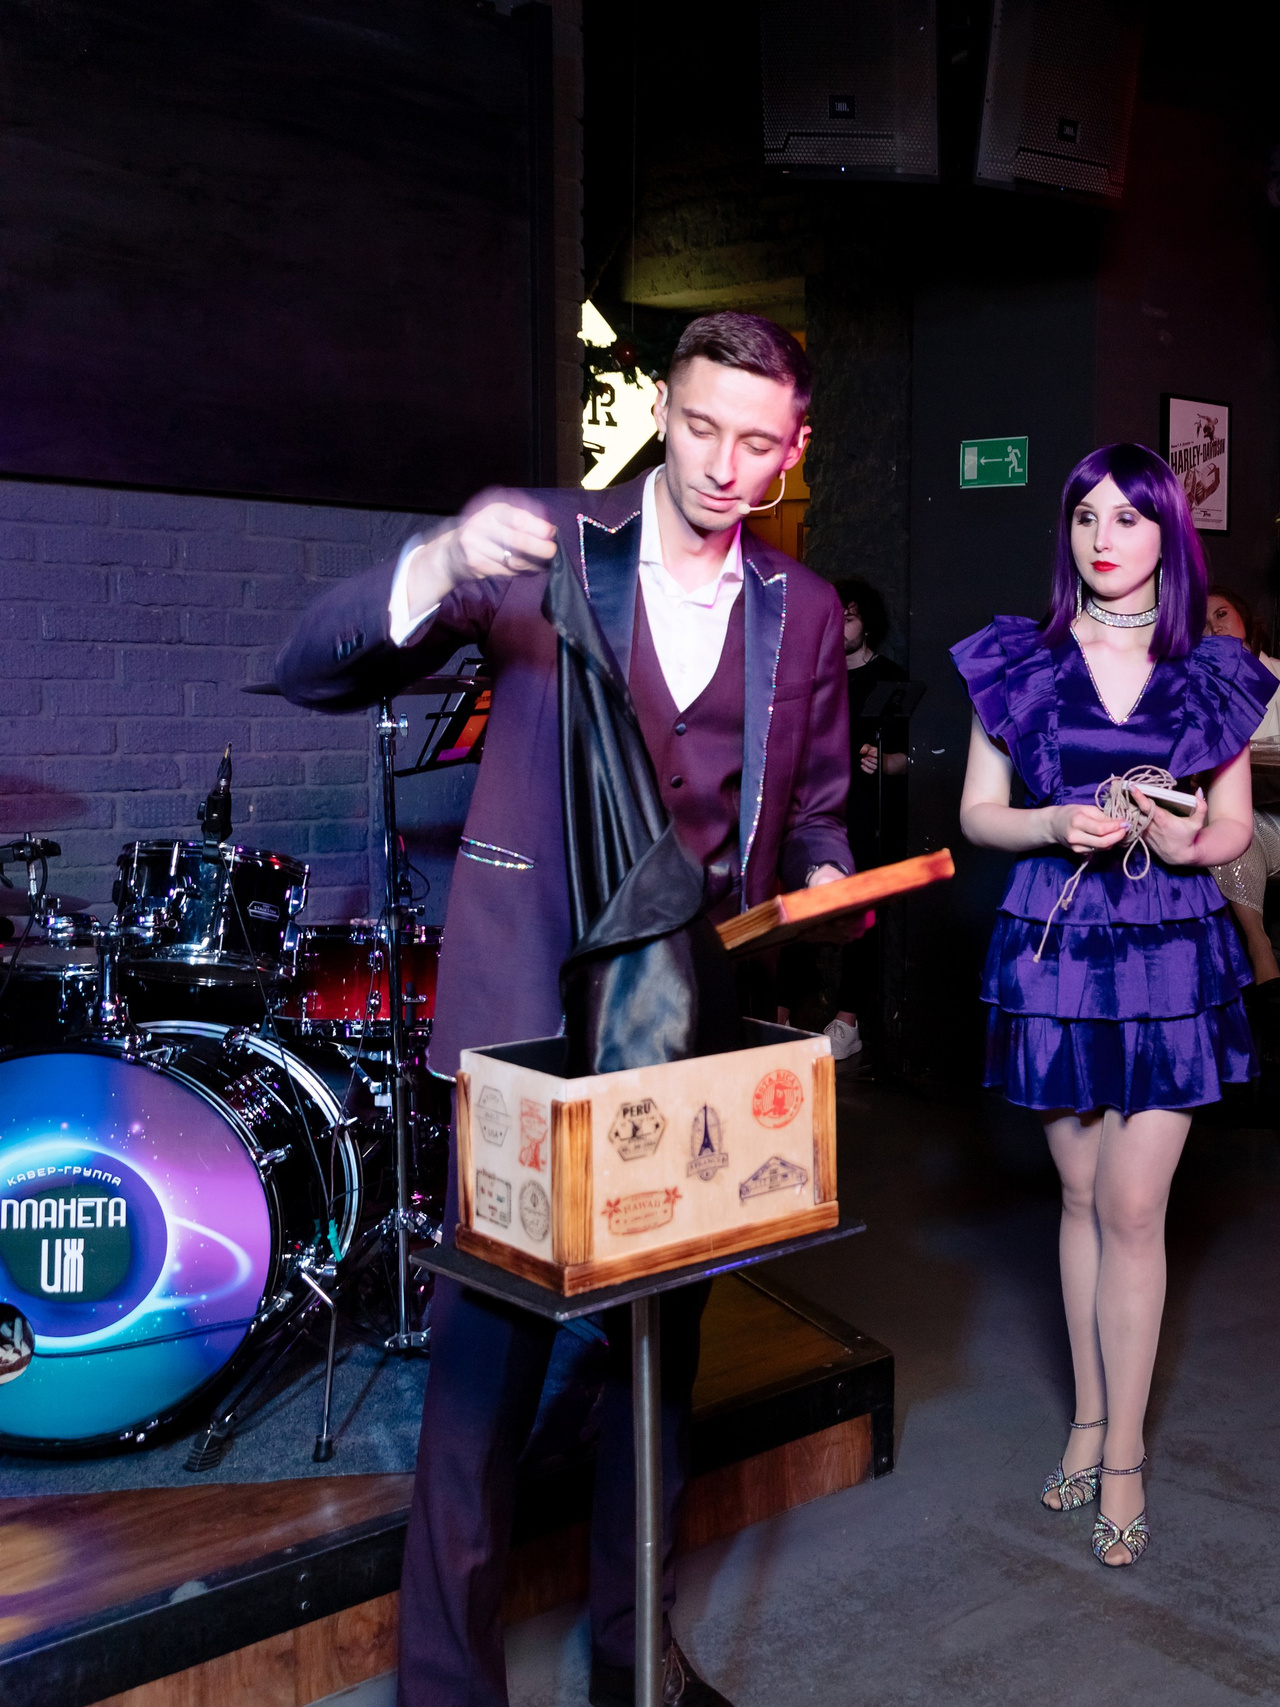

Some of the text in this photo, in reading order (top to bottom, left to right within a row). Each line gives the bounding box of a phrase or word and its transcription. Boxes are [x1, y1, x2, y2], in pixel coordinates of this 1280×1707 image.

[1171, 438, 1225, 476] HARLEY-DAVIDSON
[622, 1101, 652, 1119] PERU
[6, 1165, 122, 1187] КАВЕР-ГРУППА
[0, 1197, 127, 1230] ПЛАНЕТА
